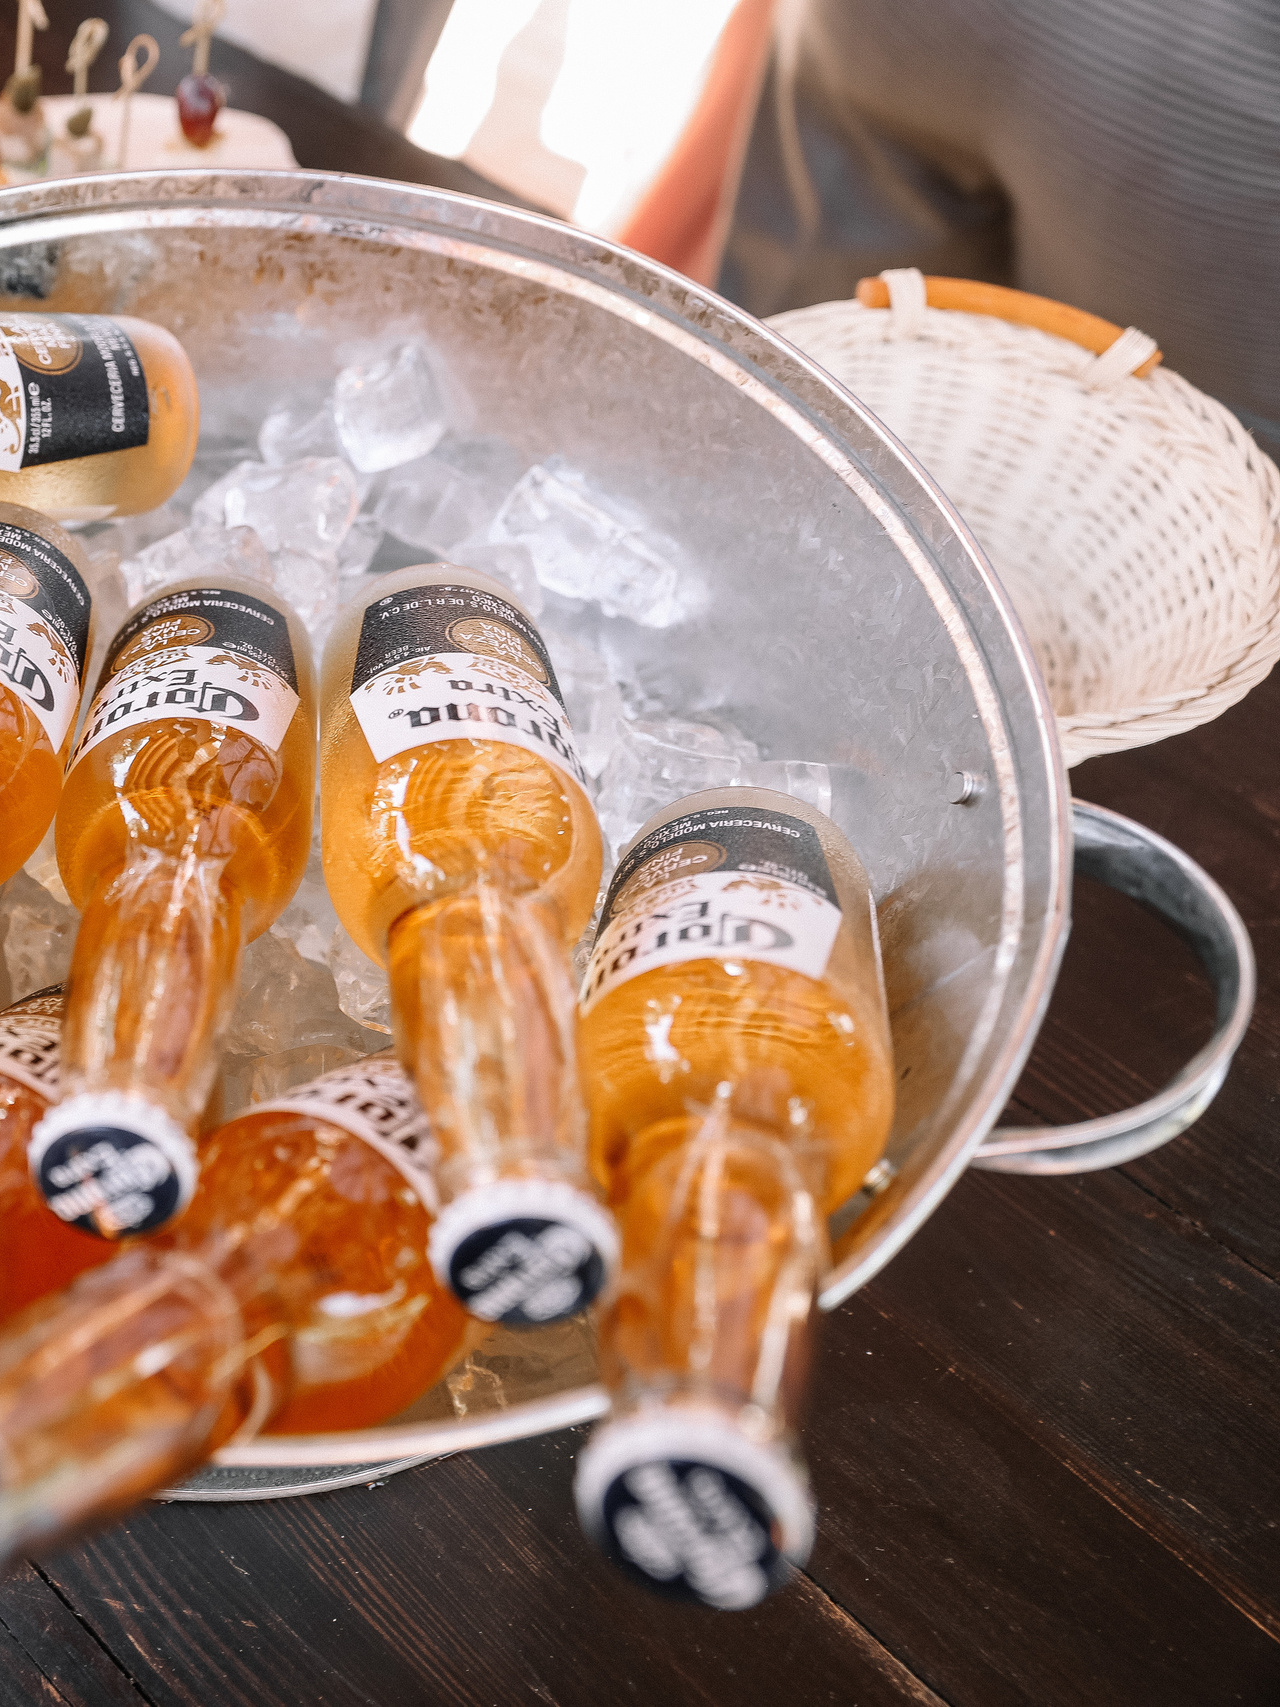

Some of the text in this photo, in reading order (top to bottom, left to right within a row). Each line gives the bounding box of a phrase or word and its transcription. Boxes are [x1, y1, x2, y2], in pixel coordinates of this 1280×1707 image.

[32, 547, 85, 606] CERVECERIA
[402, 600, 420, 610] DE
[448, 597, 464, 606] DE
[202, 599, 274, 625] CERVECERIA
[379, 605, 400, 619] C.V.
[140, 625, 178, 643] MAS
[141, 618, 182, 635] FINA
[479, 621, 521, 642] FINA
[143, 638, 167, 651] LA
[481, 629, 522, 651] MAS
[384, 644, 409, 658] BEER
[459, 632, 543, 673] CERVEZA
[493, 646, 518, 663] LA
[447, 679, 563, 739] Extra
[709, 818, 801, 838] CERVECERIA
[638, 853, 681, 879] MAS
[639, 847, 684, 872] FINA
